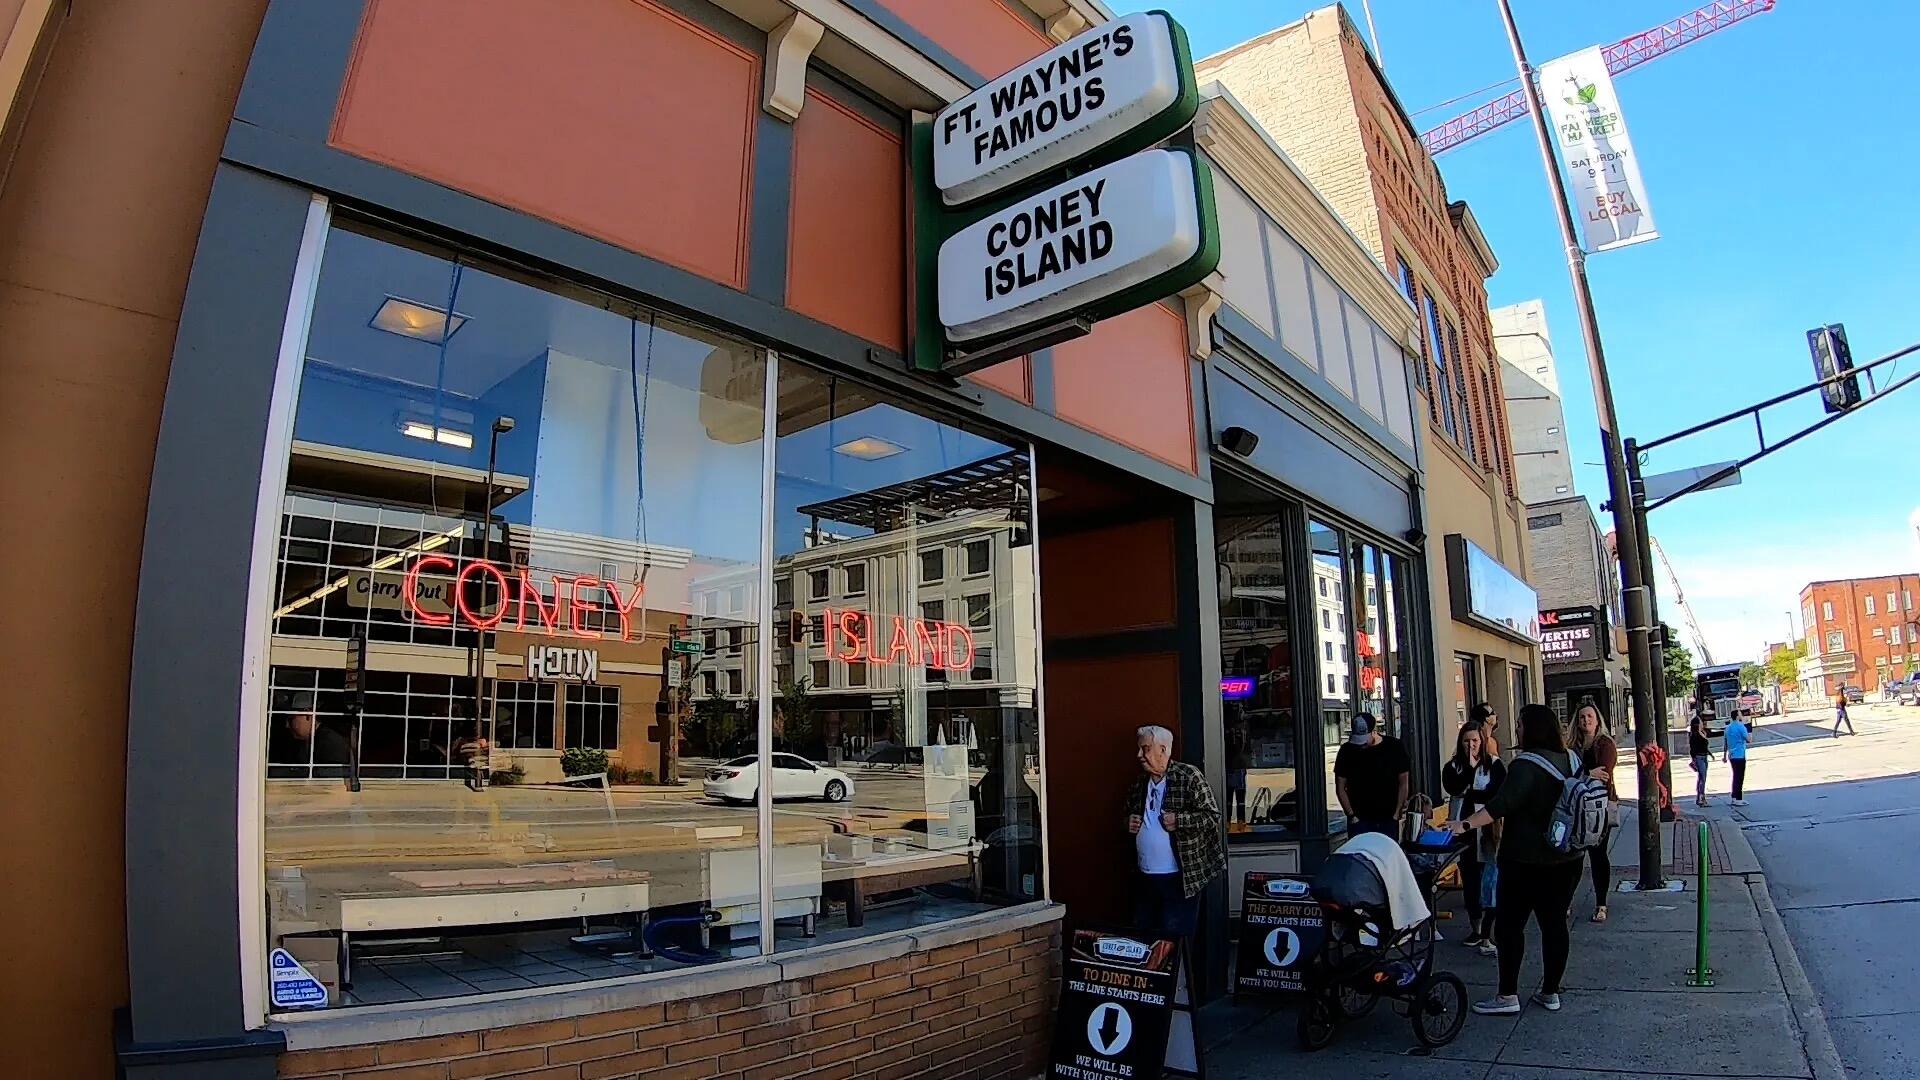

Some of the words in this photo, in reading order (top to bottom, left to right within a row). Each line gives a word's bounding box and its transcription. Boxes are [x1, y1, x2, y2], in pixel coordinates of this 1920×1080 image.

[944, 102, 981, 145] FT.
[990, 25, 1133, 118] WAYNE'S
[974, 77, 1105, 164] FAMOUS
[1587, 168, 1596, 179] 9
[1611, 164, 1617, 174] 1
[1596, 191, 1625, 207] BUY
[987, 178, 1106, 258] CONEY
[1589, 202, 1641, 222] LOCAL
[985, 220, 1113, 302] ISLAND
[357, 577, 402, 599] Carry
[404, 553, 645, 642] CONEY
[824, 608, 976, 671] ISLAND
[1539, 628, 1591, 642] VERTISE
[1220, 682, 1249, 693] PEN
[1248, 904, 1267, 913] THE
[1269, 905, 1301, 916] CARRY
[1247, 915, 1266, 924] LINE
[1268, 916, 1298, 926] STARTS
[1300, 918, 1323, 927] HERE
[1083, 968, 1099, 980] TO
[1101, 969, 1131, 986] DINE
[1133, 976, 1148, 989] IN
[1240, 977, 1261, 986] WITH
[1263, 979, 1279, 988] YOU
[1256, 969, 1268, 977] WE
[1271, 970, 1290, 979] WILL
[1069, 980, 1085, 991] THE
[1087, 983, 1106, 995] LINE
[1107, 987, 1139, 1000] STARTS
[1140, 993, 1165, 1005] HERE
[1055, 1063, 1081, 1078] WITH
[1076, 1054, 1092, 1067] WE
[1093, 1058, 1118, 1073] WILL
[1119, 1064, 1133, 1077] BE
